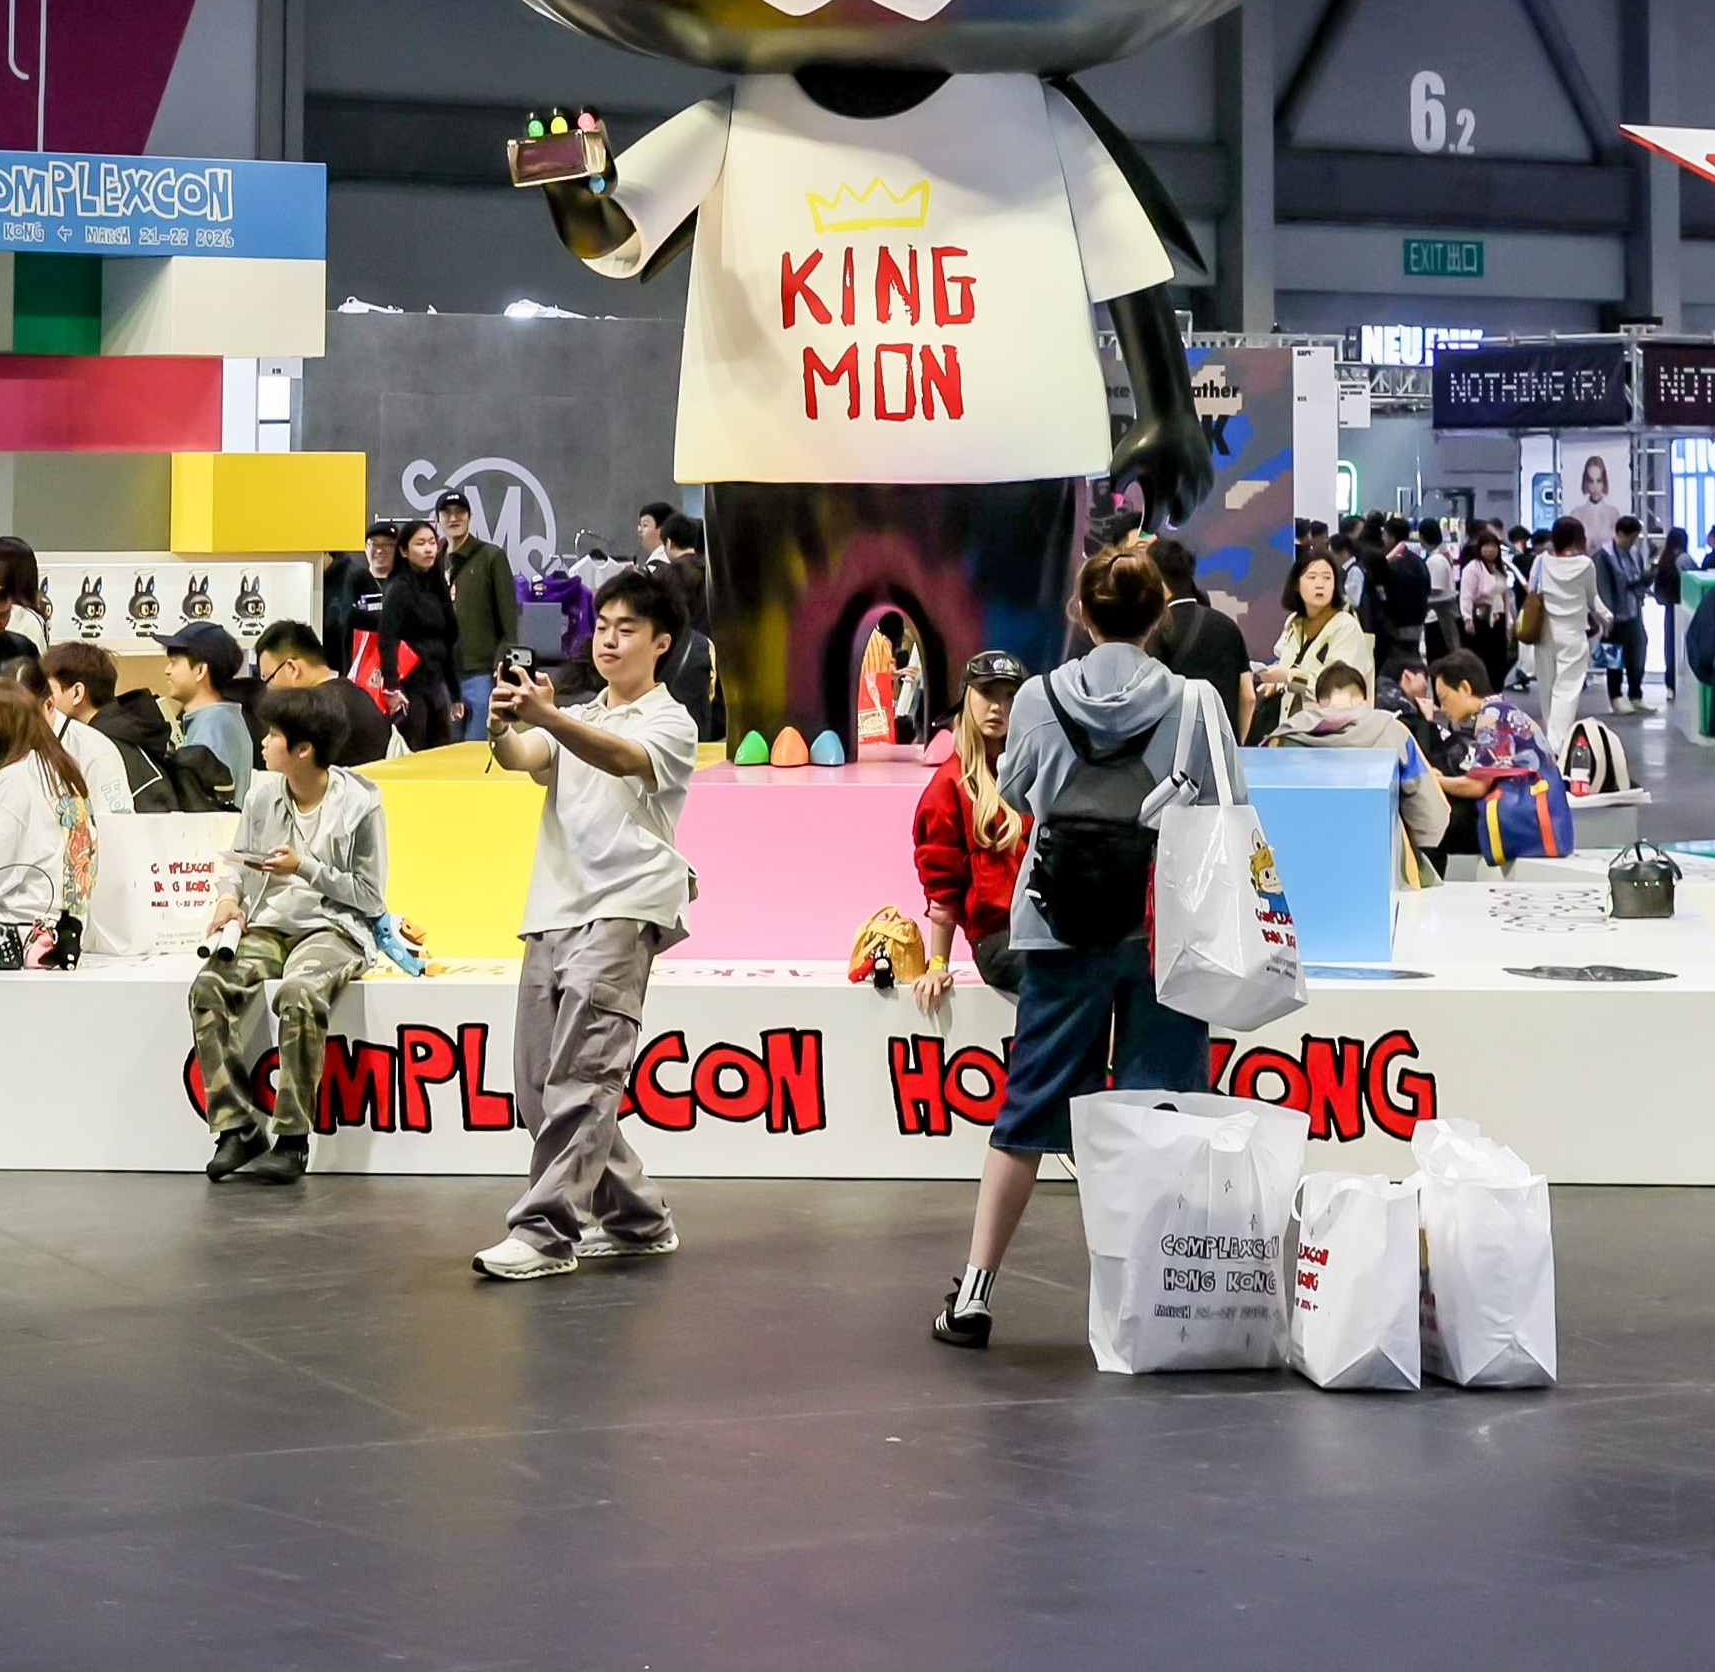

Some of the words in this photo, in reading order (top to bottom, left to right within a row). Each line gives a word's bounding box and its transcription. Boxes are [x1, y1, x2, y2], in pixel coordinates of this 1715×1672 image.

[1410, 70, 1476, 154] 6.2
[3, 222, 45, 242] KONG
[85, 225, 131, 245] MARCH
[139, 226, 189, 246] 21-22
[195, 228, 235, 248] 2026
[1409, 242, 1443, 272] EXIT
[1446, 244, 1478, 273] 出口
[780, 243, 977, 330] KING
[802, 341, 965, 422] MON
[1191, 380, 1240, 399] ather
[1449, 372, 1565, 404] NOTHING
[1163, 1266, 1216, 1293] HONG
[1226, 1268, 1277, 1296] KONG
